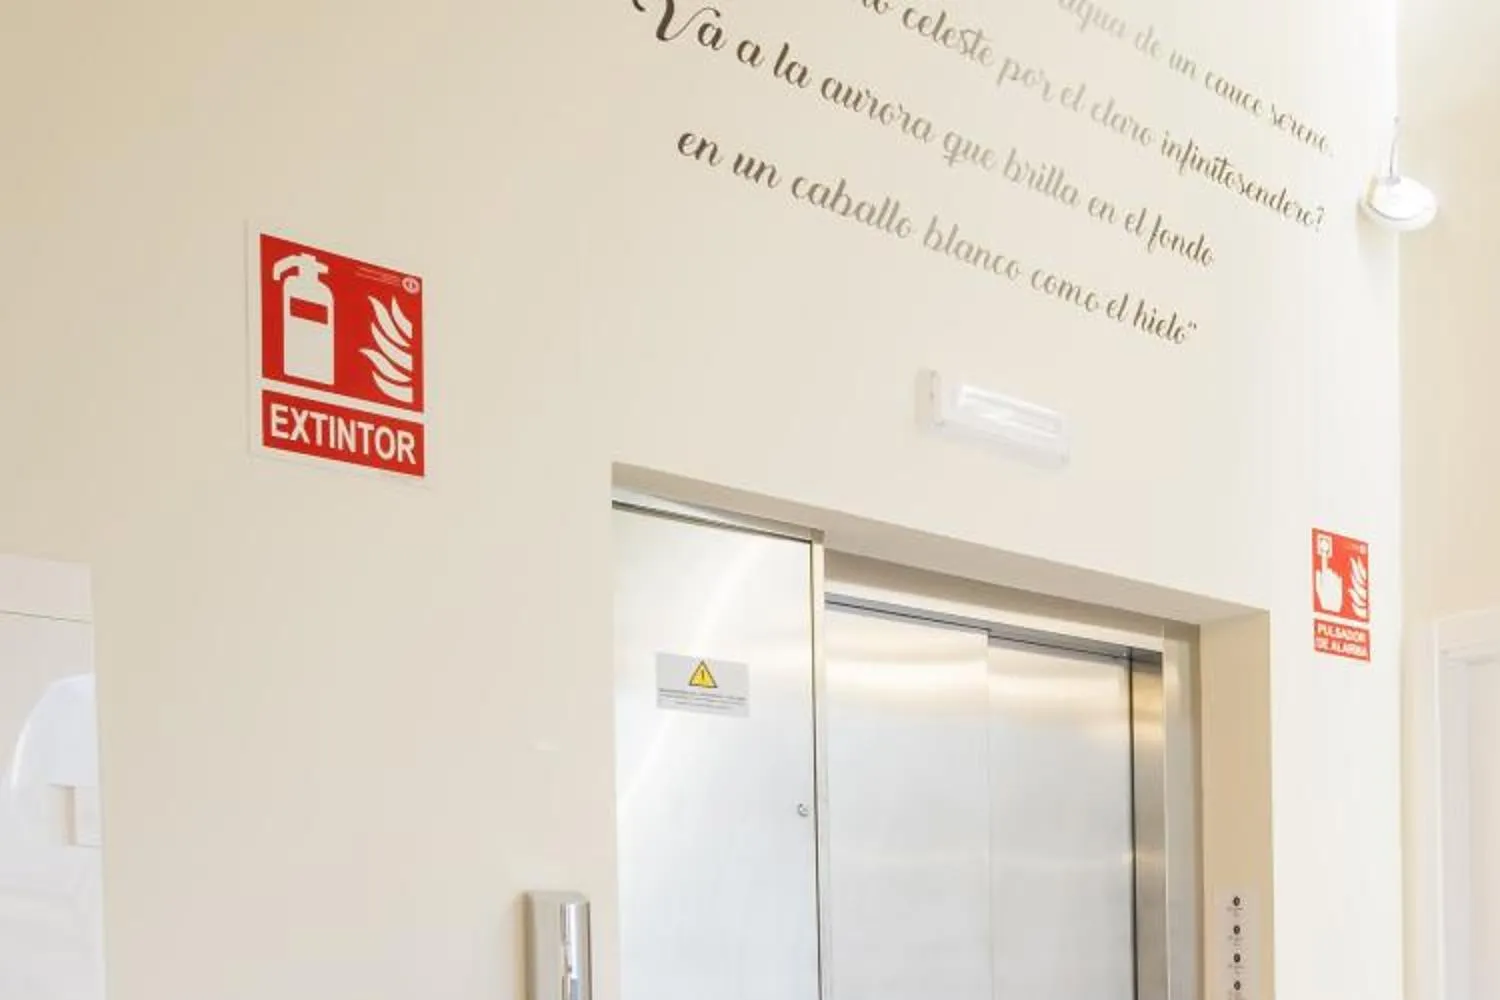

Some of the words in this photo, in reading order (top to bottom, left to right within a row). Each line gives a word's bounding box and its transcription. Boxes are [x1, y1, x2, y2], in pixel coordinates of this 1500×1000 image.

[901, 6, 994, 66] celeste
[996, 56, 1054, 101] por
[1060, 82, 1086, 113] el
[1090, 98, 1154, 148] claro
[1133, 23, 1162, 60] de
[1168, 47, 1199, 81] un
[736, 38, 765, 67] a
[773, 42, 812, 89] la
[820, 76, 936, 144] aurora
[943, 129, 996, 171] que
[1003, 148, 1081, 208] brilla
[1087, 194, 1116, 224] en
[1123, 206, 1148, 237] el
[1147, 214, 1214, 268] fondo
[676, 131, 723, 167] en
[733, 151, 782, 189] un
[790, 176, 913, 240] caballo
[923, 215, 1021, 280] blanco
[1030, 267, 1100, 313] como
[1105, 293, 1131, 323] el
[270, 402, 416, 465] EXTINTOR
[1316, 636, 1329, 650] DE
[1331, 640, 1368, 657] ALARMA
[1317, 623, 1366, 644] PULSADOR
